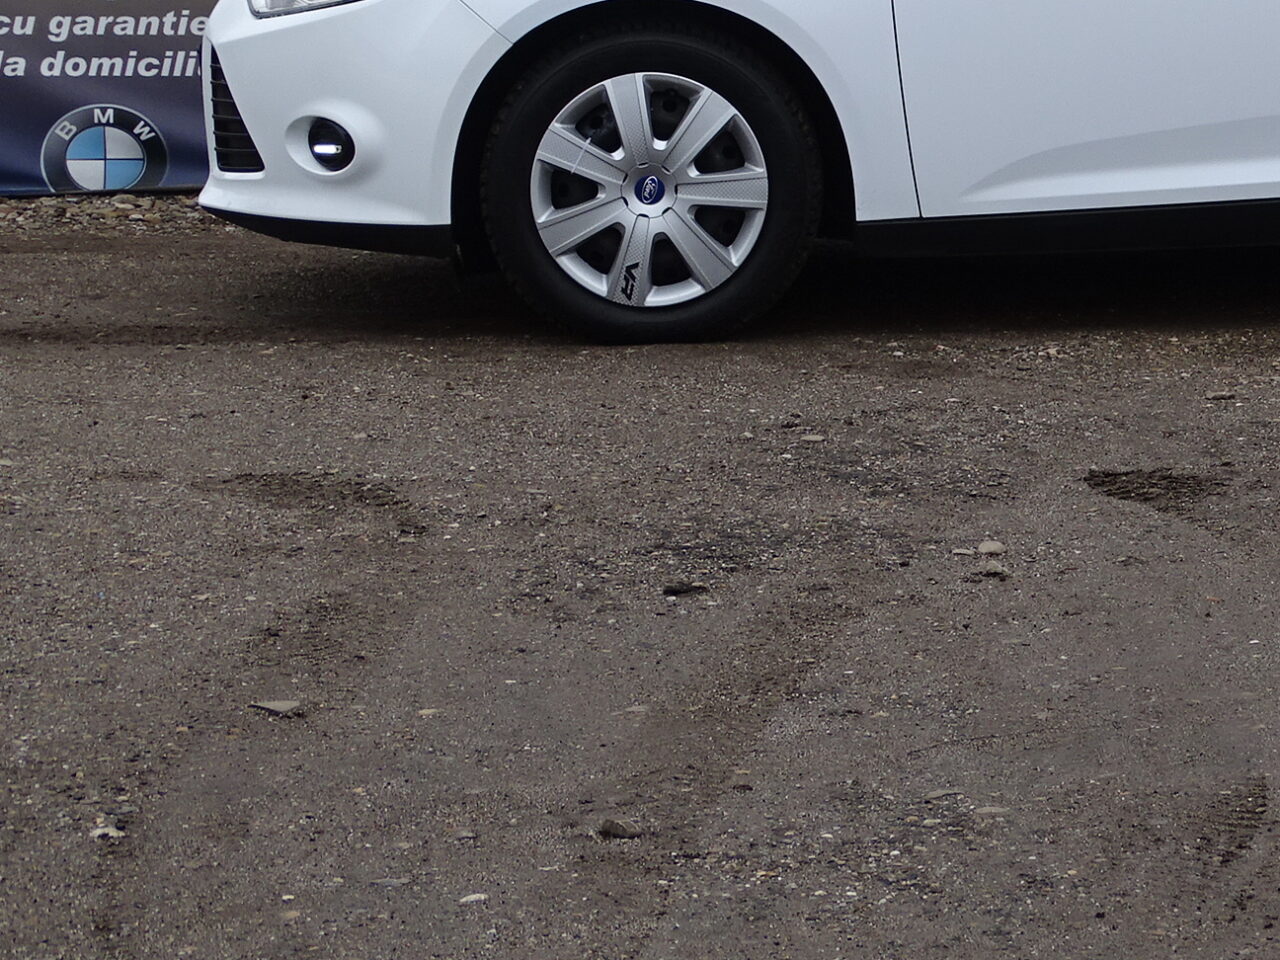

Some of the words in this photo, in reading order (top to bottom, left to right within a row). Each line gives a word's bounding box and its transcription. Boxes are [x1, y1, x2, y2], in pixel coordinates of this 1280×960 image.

[47, 9, 209, 43] garantie
[39, 50, 202, 78] domicili
[54, 108, 156, 141] BMW
